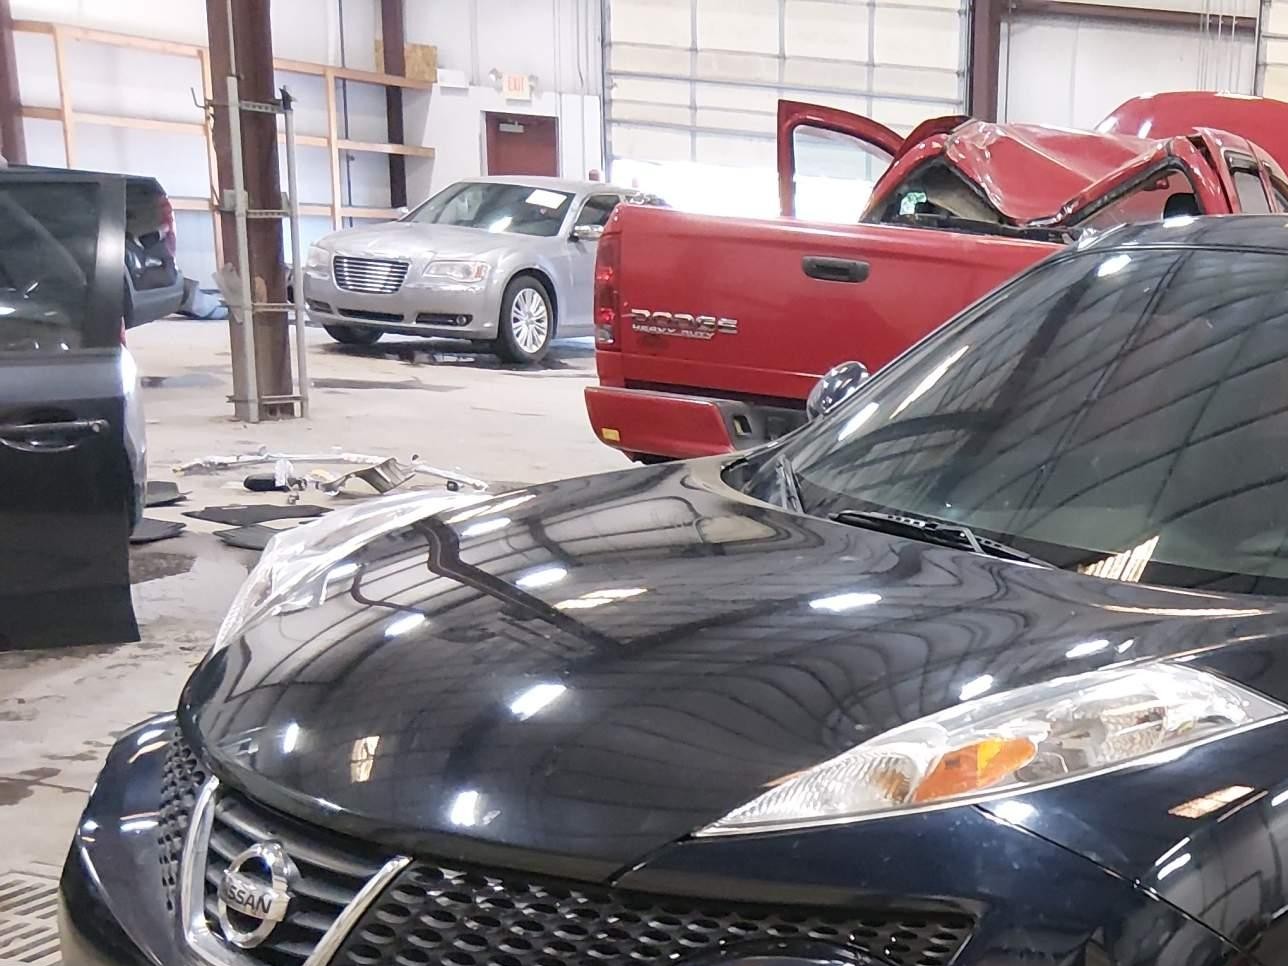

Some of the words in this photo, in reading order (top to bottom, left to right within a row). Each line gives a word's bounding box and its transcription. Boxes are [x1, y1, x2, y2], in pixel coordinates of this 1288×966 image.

[508, 76, 525, 91] EXIT
[631, 308, 738, 334] DODGE
[632, 323, 677, 335] HEAVY
[680, 328, 716, 340] DUTY
[222, 881, 272, 914] SSAN
